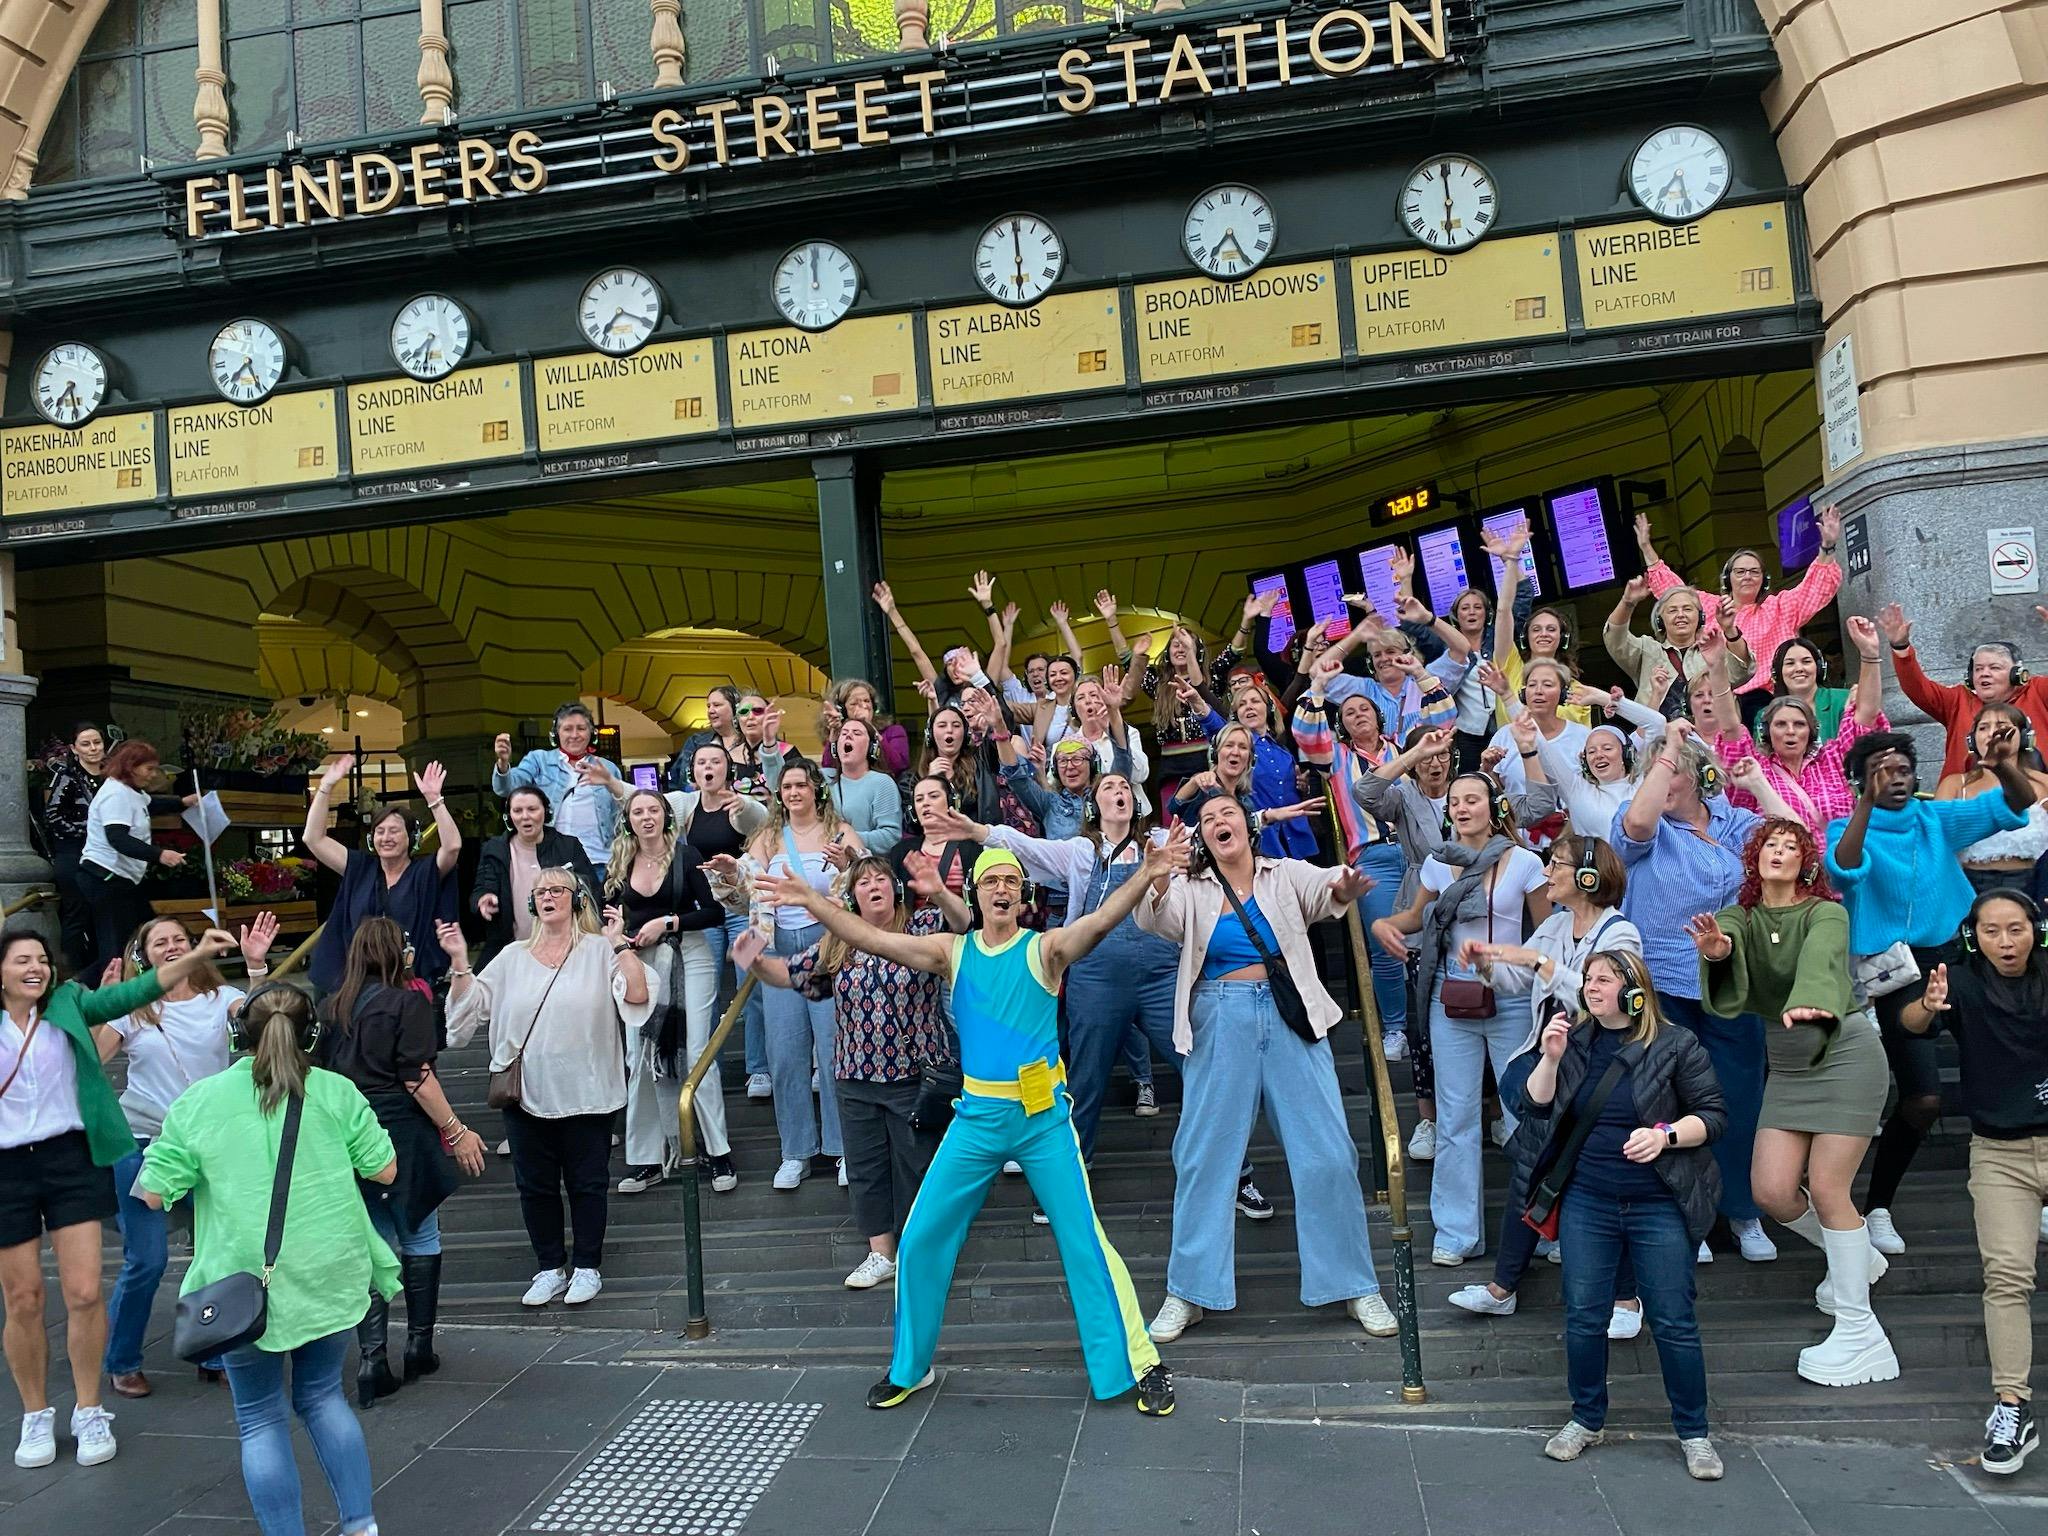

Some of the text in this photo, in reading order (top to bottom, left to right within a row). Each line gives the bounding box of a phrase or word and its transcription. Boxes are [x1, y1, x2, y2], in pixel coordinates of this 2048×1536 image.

[186, 0, 1446, 239] FLINDERS STREET STATION
[1588, 225, 1700, 257] WERRIBEE
[1364, 257, 1447, 284] UPFIELD
[1591, 263, 1638, 286] LINE
[1146, 273, 1319, 313] BROADMEADOWS
[1366, 289, 1410, 312] LINE
[1595, 291, 1675, 312] PLATFORM
[939, 309, 1041, 338] ST ALBANS
[1149, 318, 1191, 340] LINE
[1368, 318, 1445, 339] PLATFORM
[1638, 326, 1740, 348] NEXT TRAIN FOR
[740, 336, 811, 360] ALTONA
[941, 344, 981, 365] LINE
[1151, 346, 1224, 366] PLATFORM
[546, 352, 682, 385] WILLIAMSTOWN
[1415, 354, 1513, 374] NEXT TRAIN FOR
[1830, 365, 1845, 381] Police
[740, 366, 780, 387] LINE
[943, 371, 1014, 390] PLATFORM
[358, 378, 483, 410] SANDRINGHAM
[1146, 385, 1239, 406] NEXT TRAIN FOR
[1827, 376, 1852, 400] Monitored
[547, 390, 584, 411] LINE
[743, 393, 811, 411] PLATFORM
[1833, 396, 1848, 412] Video
[174, 407, 272, 434] FRANKSTON
[359, 415, 395, 435] LINE
[549, 417, 615, 435] PLATFORM
[941, 411, 1029, 429] NEXT TRAIN FOR
[6, 427, 116, 454] PAKENHAM and
[175, 440, 210, 459] LINE
[361, 441, 425, 459] PLATFORM
[736, 434, 806, 450] NEXT TRAIN FOR
[7, 448, 150, 478] CRANBOURNE LINES
[544, 455, 628, 474] NEXT TRAIN FOR
[176, 466, 238, 482] PLATFORM
[7, 485, 67, 501] PLATFORM
[358, 478, 439, 496] NEXT TRAIN FOR
[177, 501, 256, 517] NEXT TRAIN FOR
